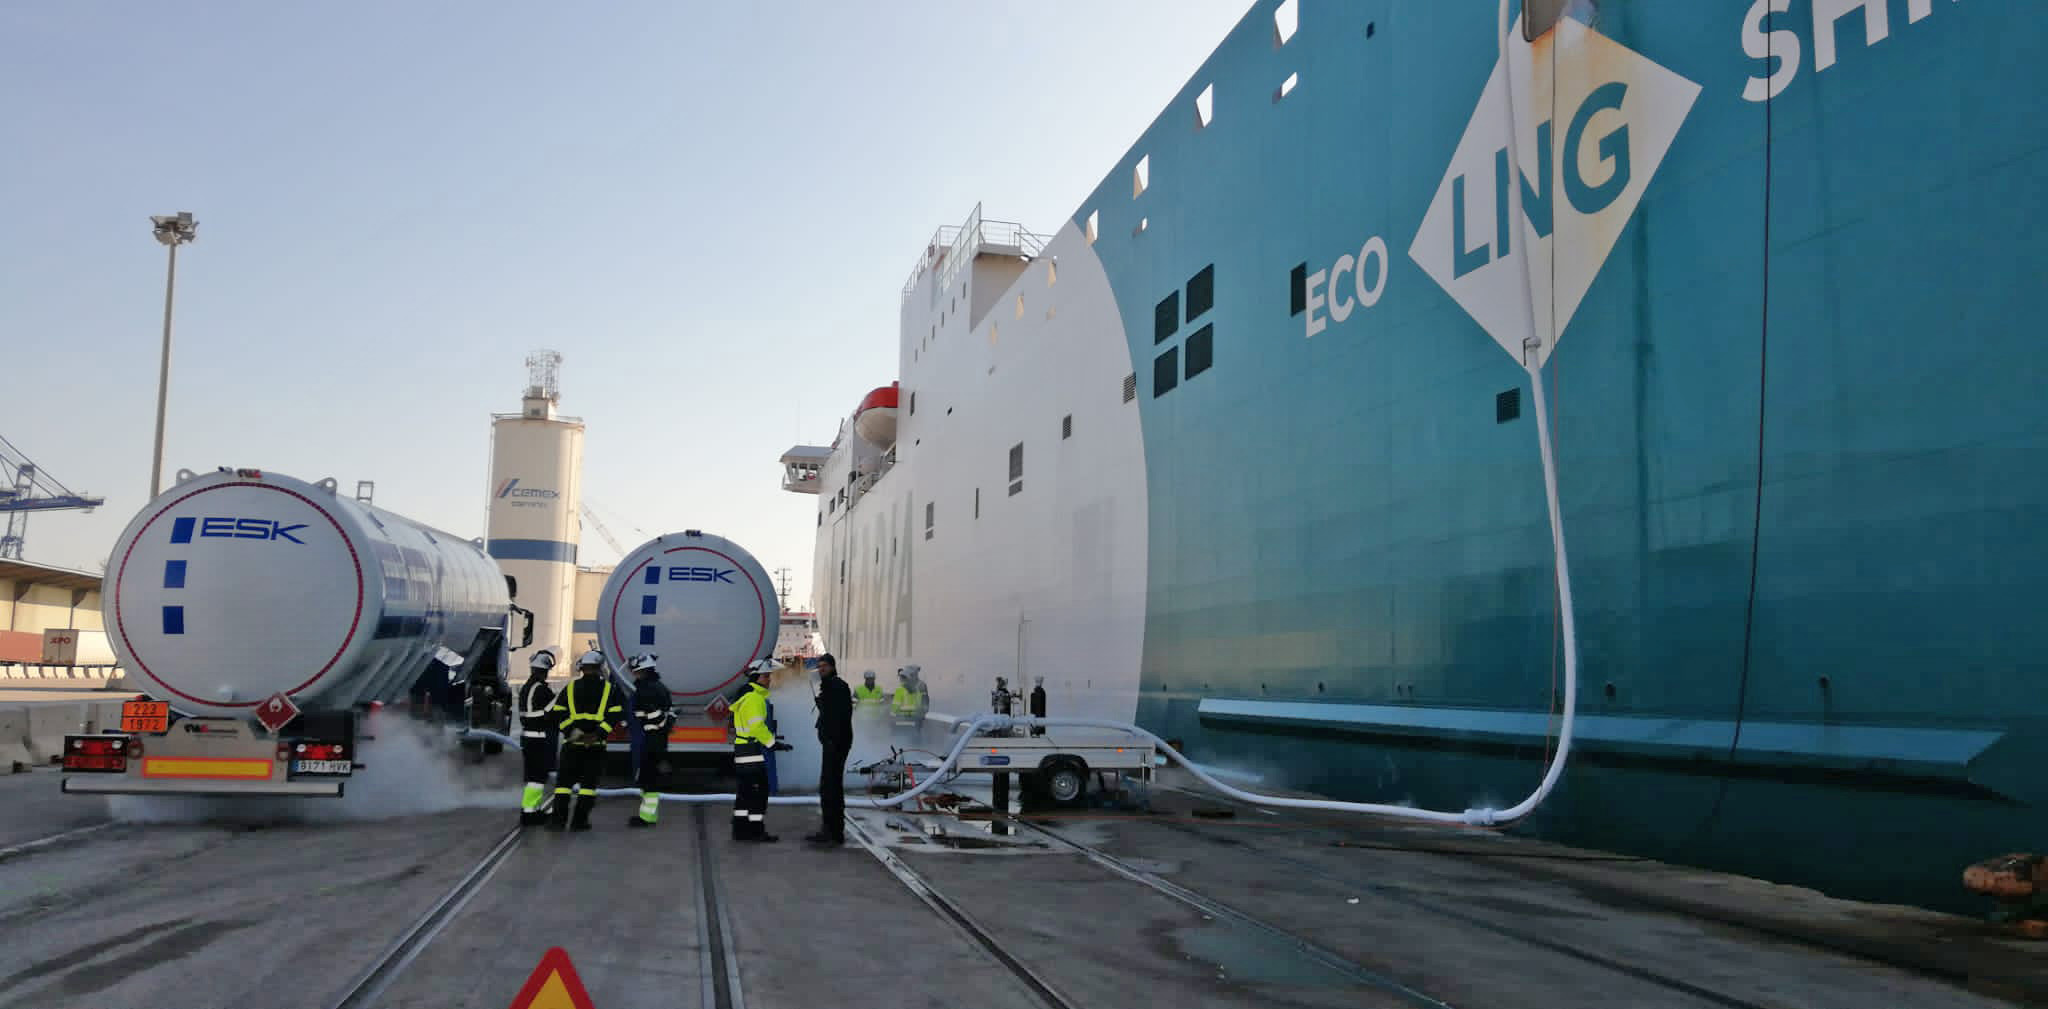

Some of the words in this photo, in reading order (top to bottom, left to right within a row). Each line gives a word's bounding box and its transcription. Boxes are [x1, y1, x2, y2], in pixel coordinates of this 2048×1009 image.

[1305, 236, 1388, 338] ECO
[1453, 82, 1630, 281] LNG
[200, 517, 310, 545] ESK
[668, 566, 736, 585] ESK
